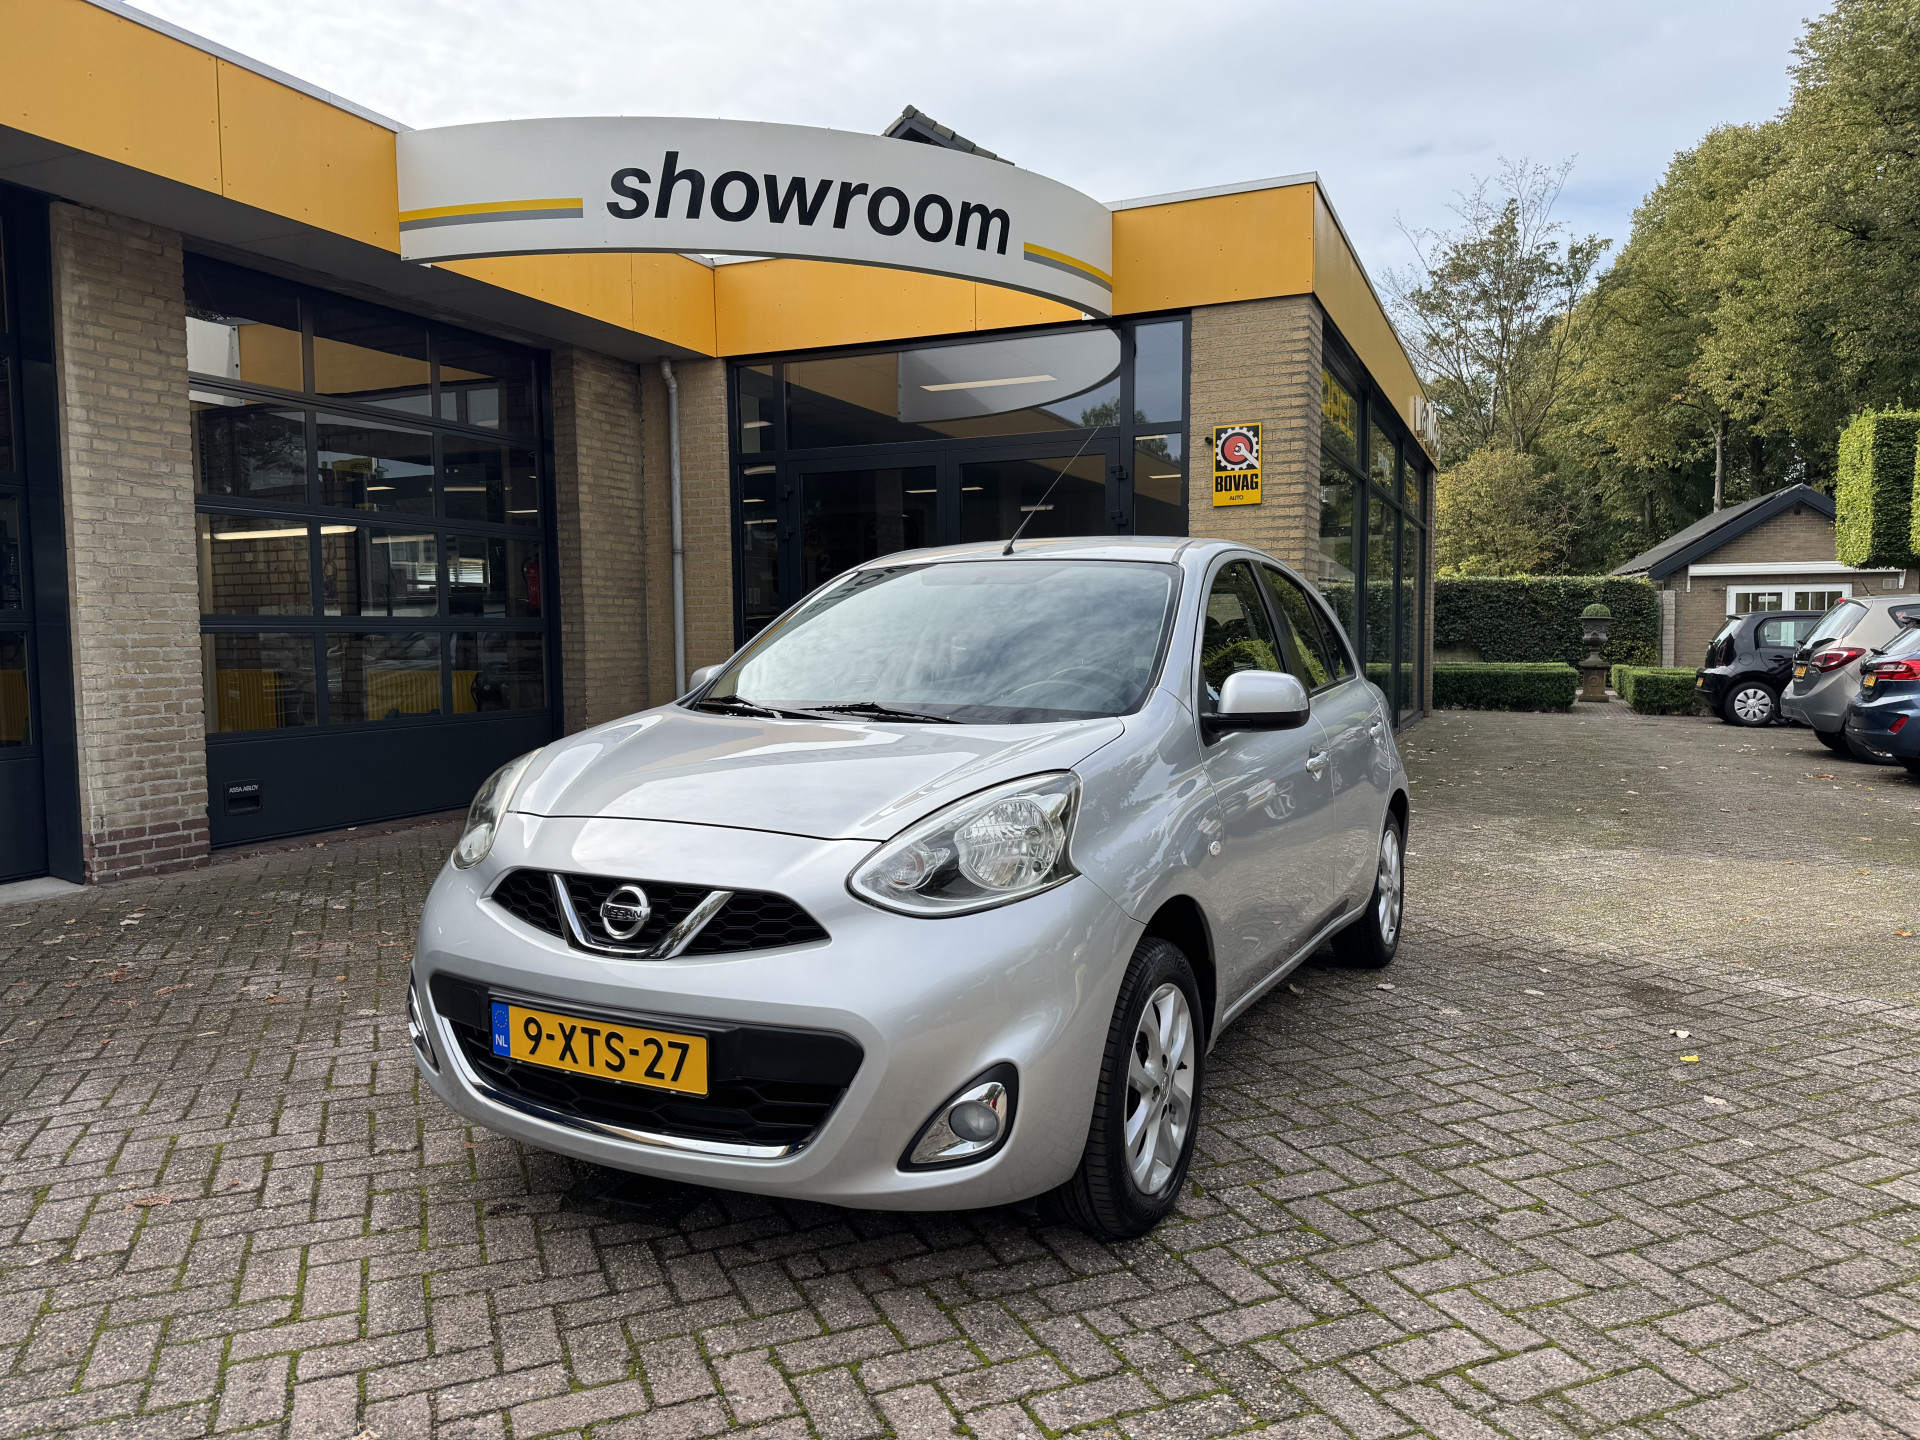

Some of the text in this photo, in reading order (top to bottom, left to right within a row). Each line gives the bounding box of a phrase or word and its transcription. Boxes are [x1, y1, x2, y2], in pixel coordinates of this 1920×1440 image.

[606, 150, 1011, 256] showroom
[1215, 473, 1259, 493] BOVAG
[242, 784, 259, 792] ABLOY
[495, 1033, 508, 1048] NL
[523, 1016, 690, 1082] 9-XTS-27
